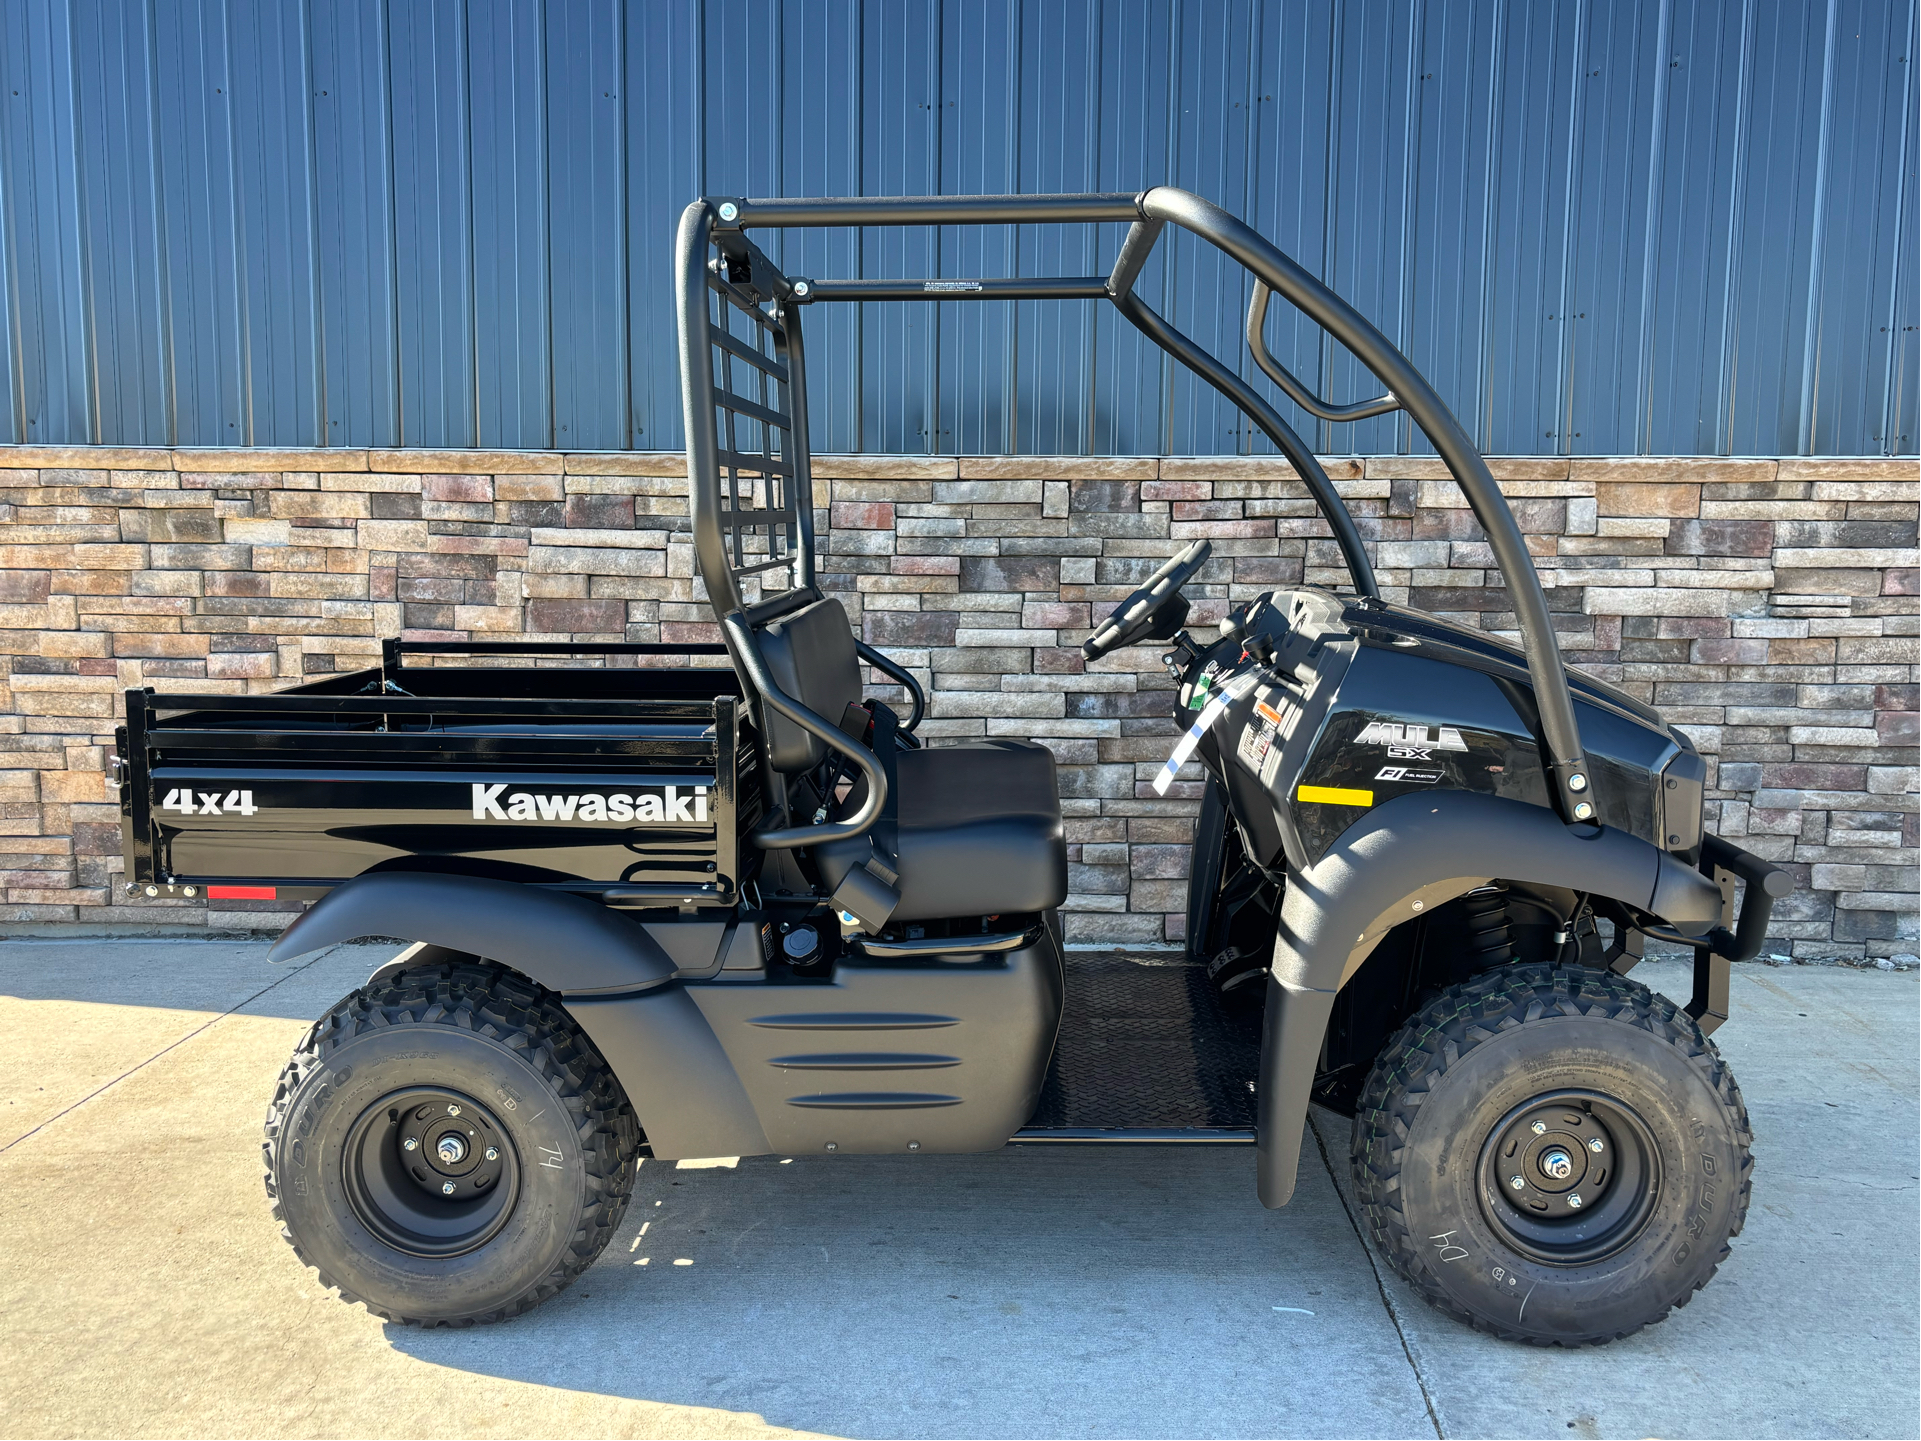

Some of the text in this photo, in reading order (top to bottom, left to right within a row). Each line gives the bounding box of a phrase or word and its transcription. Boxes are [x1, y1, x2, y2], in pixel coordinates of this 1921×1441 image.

[1353, 722, 1469, 752] MULE
[1387, 746, 1433, 761] SX
[1380, 769, 1401, 778] FI
[162, 788, 258, 816] 4x4
[472, 783, 708, 822] Kawasaki
[291, 1064, 354, 1169] DURO
[1671, 1152, 1718, 1267] DURO
[1428, 1229, 1470, 1264] D4
